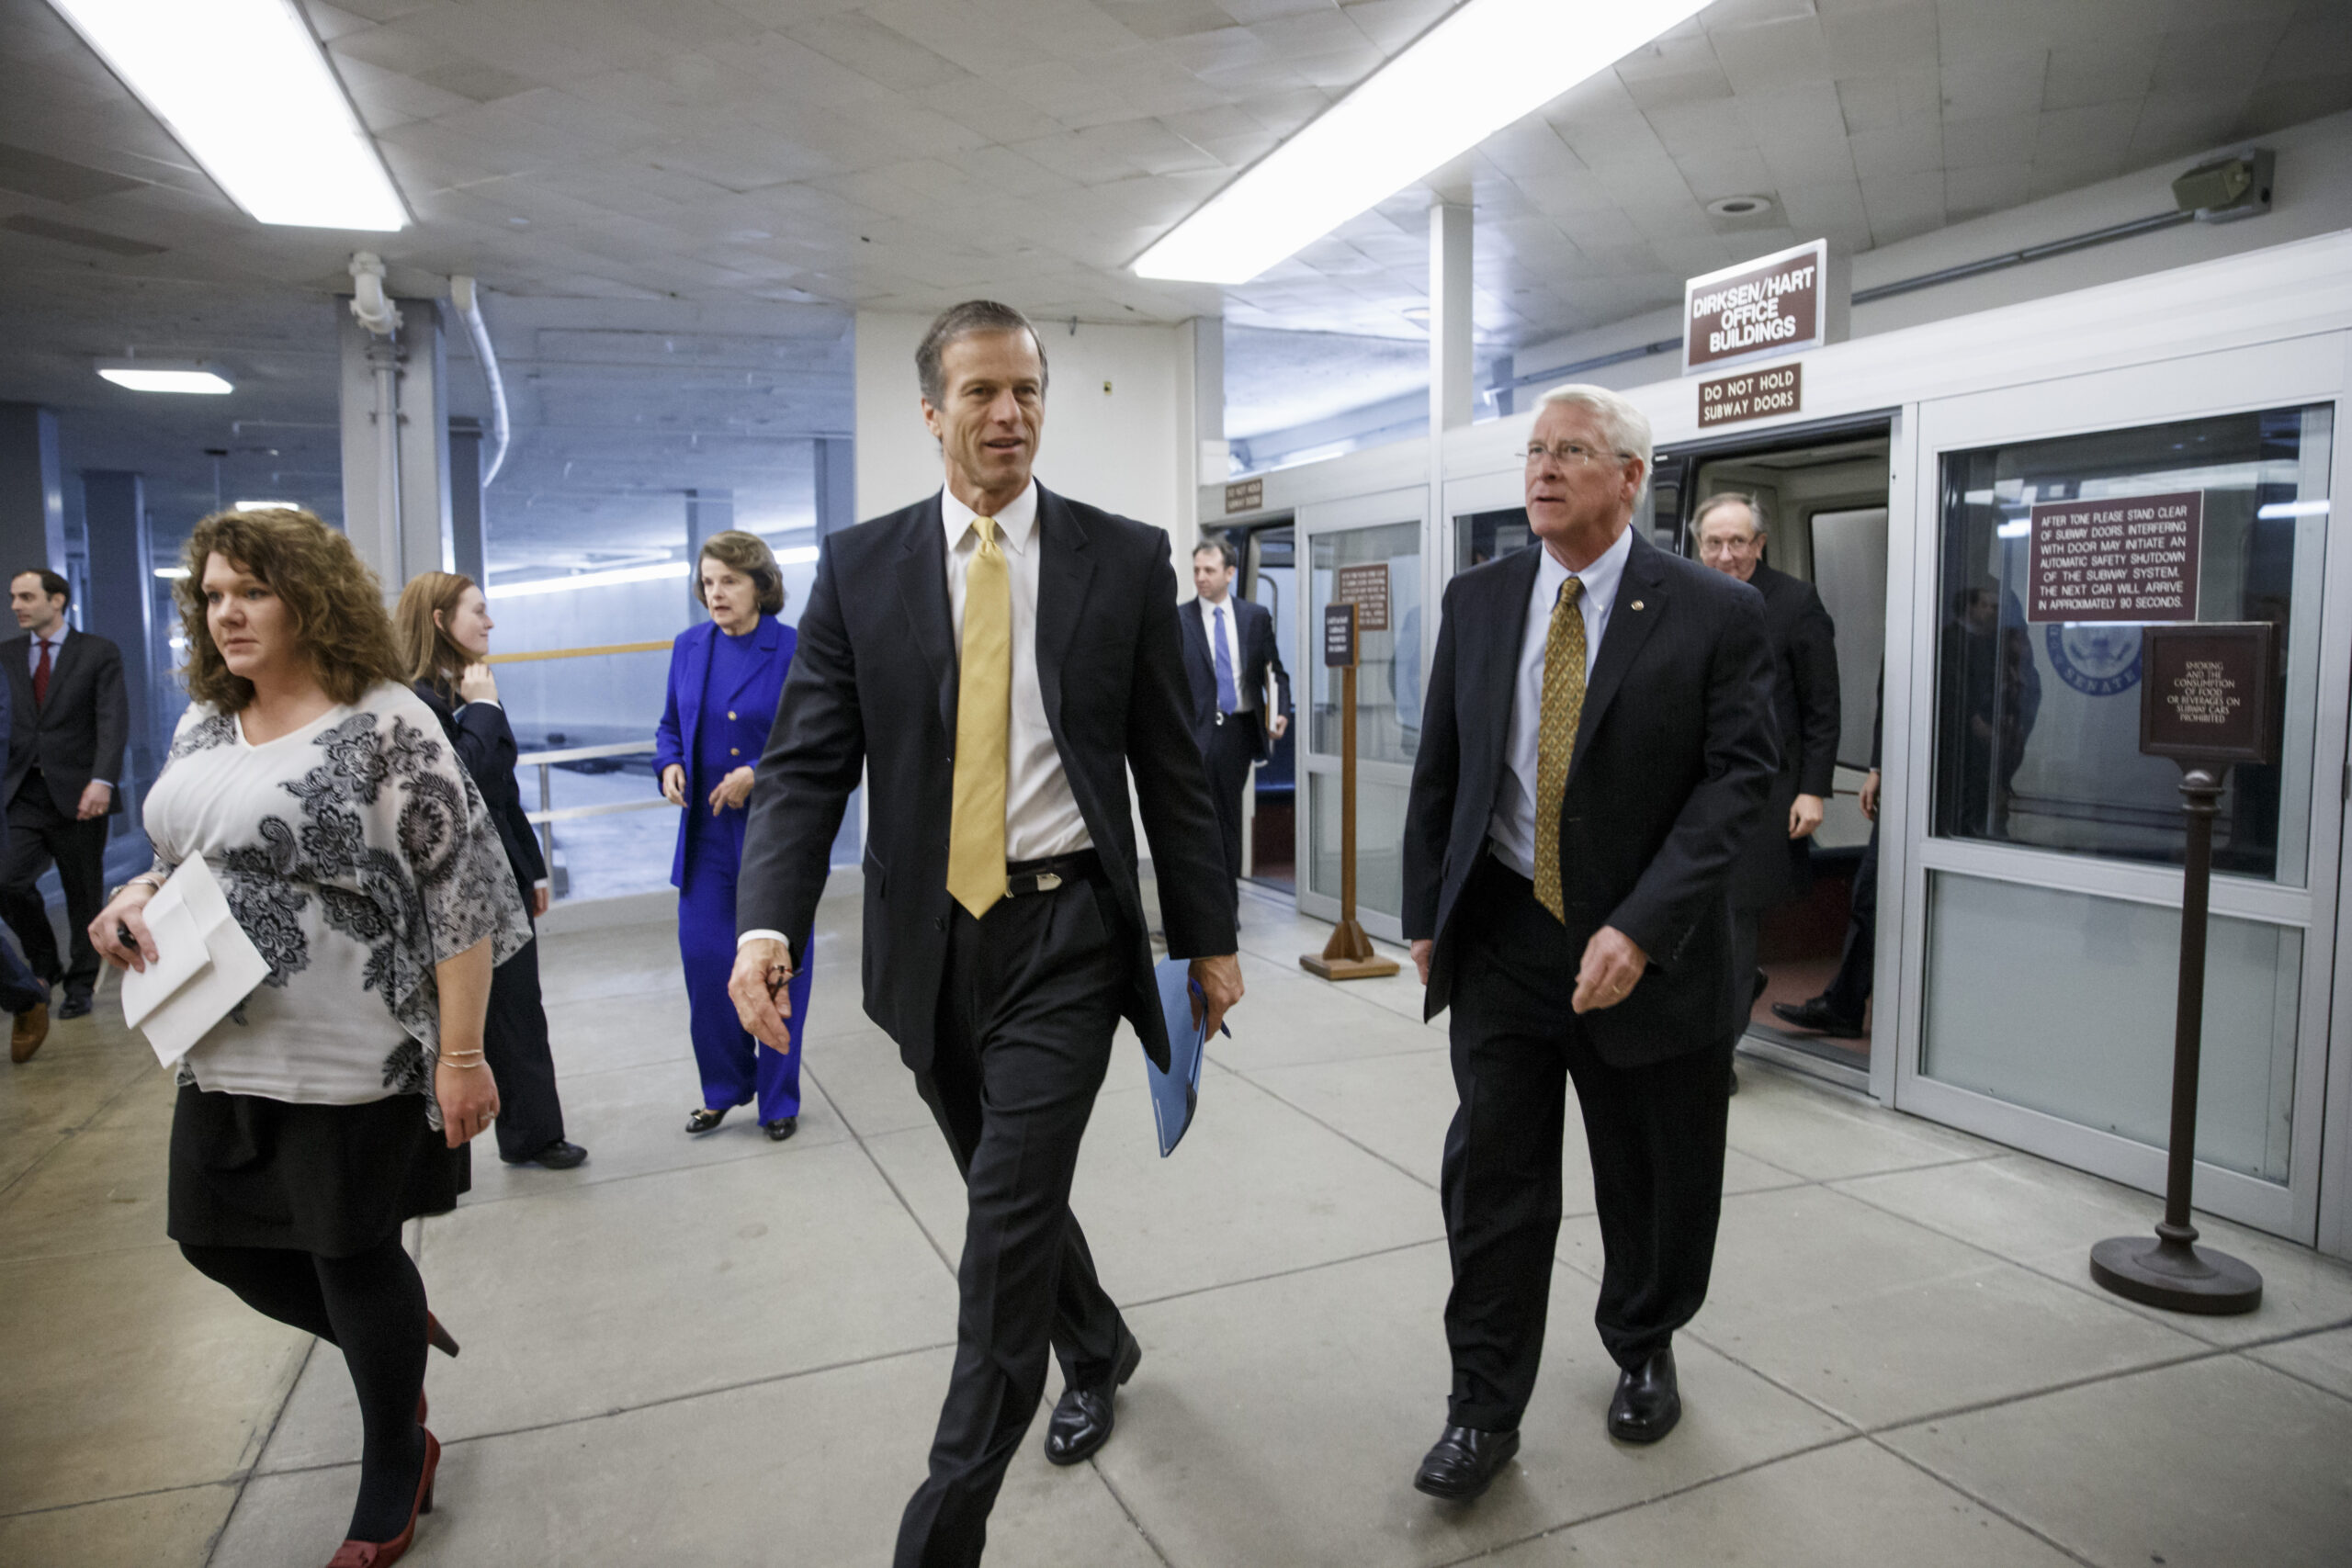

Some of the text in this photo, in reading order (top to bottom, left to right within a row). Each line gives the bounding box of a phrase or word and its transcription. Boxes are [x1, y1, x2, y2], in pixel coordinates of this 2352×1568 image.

[1692, 265, 1815, 320] DIRKSEN/HART
[1720, 297, 1780, 331] OFFICE
[1709, 315, 1796, 353] BUILDINGS
[1704, 370, 1794, 402] DO NOT HOLD
[1703, 390, 1794, 422] SUBWAY DOORS
[2041, 505, 2188, 528] AFTER TONE PLEASE STAND CLEAR
[2041, 521, 2188, 542] OF SUBWAY DOORS. INTERFERING
[2041, 536, 2187, 556] WITH DOOR MAY INITIATE AN
[2040, 551, 2186, 570] AUTOMATIC SAFETY SHUTDOWN
[2042, 566, 2180, 583] OF THE SUBWAY SYSTEM.
[2040, 580, 2184, 597] THE NEXT CAR WILL ARRIVE
[2038, 596, 2183, 611] IN APPROXIMATELY 90 SECONDS.
